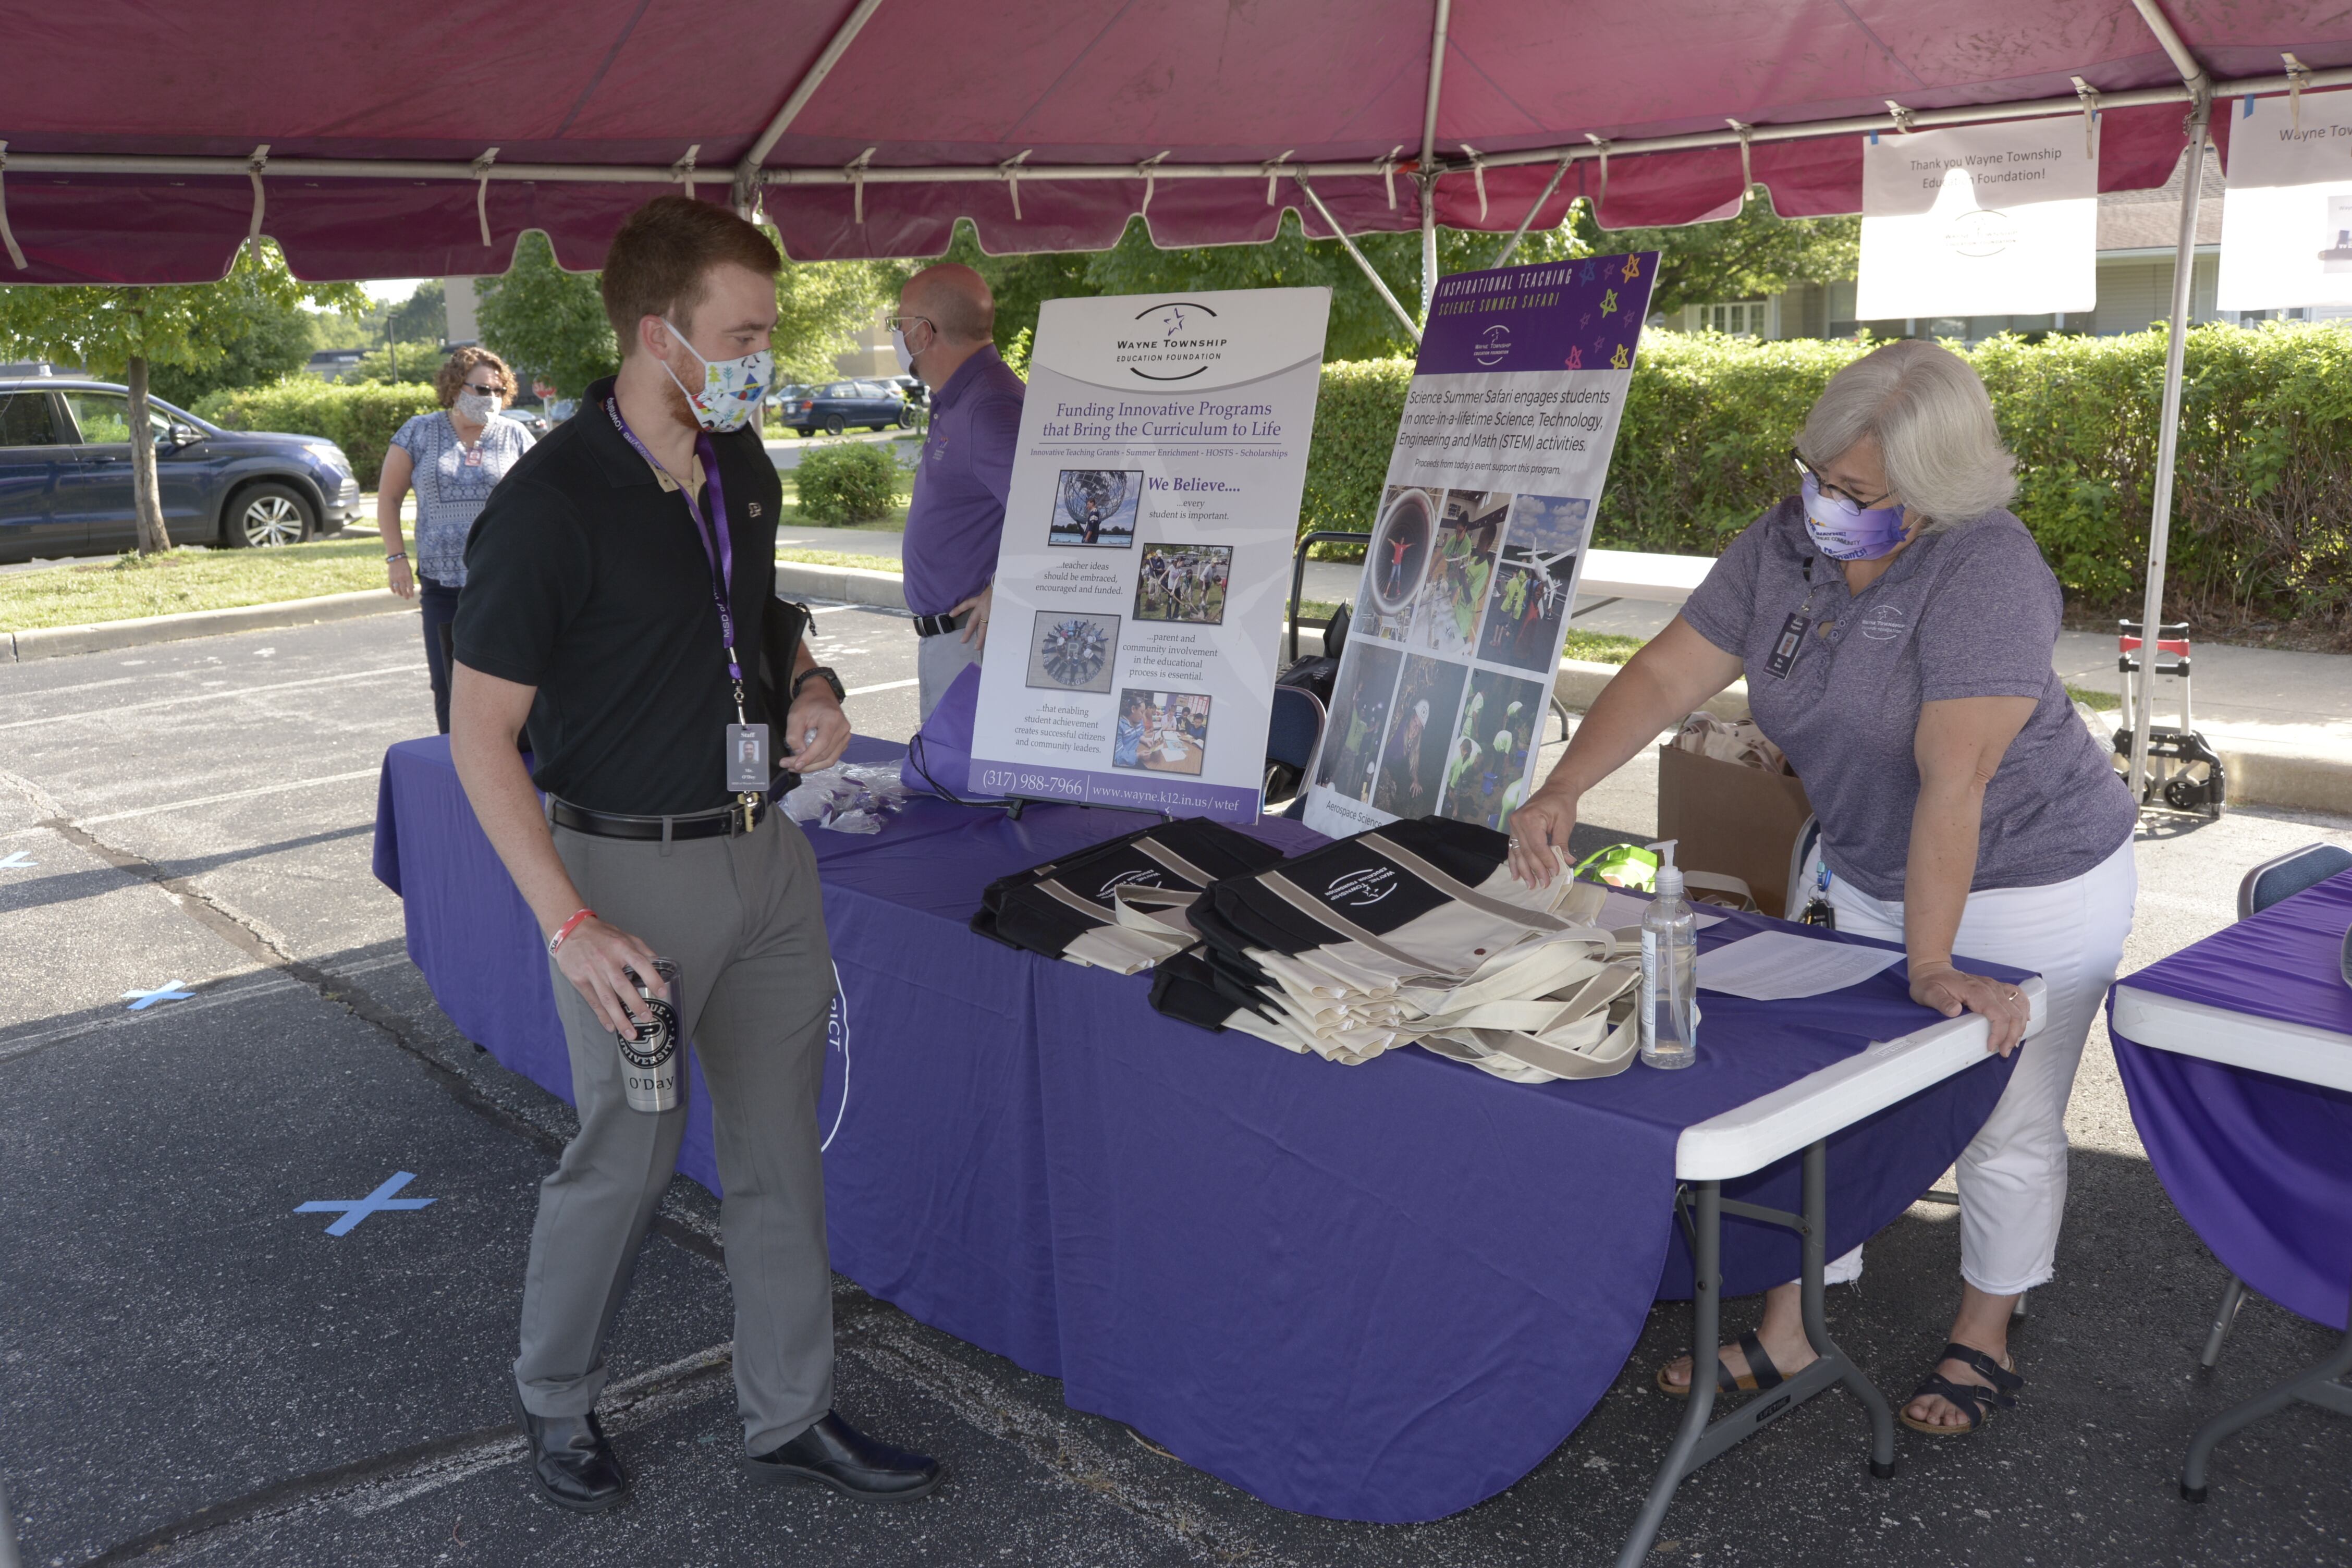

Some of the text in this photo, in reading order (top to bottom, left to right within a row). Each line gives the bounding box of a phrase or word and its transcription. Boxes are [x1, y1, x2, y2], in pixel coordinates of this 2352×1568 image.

[1910, 148, 2062, 171] Thank you Wayne Township
[1922, 168, 2045, 189] Educn Foundation!
[1439, 268, 1573, 297] INSPIRATIONAL TEACHING
[1439, 292, 1560, 316] SCIENCE SUMMER SAFARI
[1117, 339, 1228, 349] WAYNE TOWNSHIP
[1409, 389, 1610, 407] Science Summer Safari engages students
[1056, 401, 1272, 420] Funding Innovative Programs
[1404, 411, 1603, 430] in once-in-a-lifetime Science, Technology,
[1043, 421, 1281, 440] that Bring the Curriculum to Life
[1399, 433, 1586, 451] Engineering and Math (STEM) activities.
[1066, 448, 1094, 457] Teaching
[1158, 448, 1199, 457] Enrichment
[1240, 448, 1288, 458] Scholarships
[1415, 459, 1439, 469] Proceeds
[1440, 460, 1453, 469] from
[1454, 461, 1474, 471] today's
[1492, 462, 1516, 474] support
[1518, 463, 1529, 472] this
[1530, 465, 1561, 475] program.
[1148, 477, 1241, 492] We Believe....
[1177, 500, 1205, 509] ...every
[1149, 511, 1178, 519] student
[1188, 511, 1229, 522] important.
[1831, 537, 1860, 546] COMMUNITY
[1056, 561, 1109, 570] ...teacher ideas
[1044, 572, 1118, 583] should be embraced,
[1035, 583, 1123, 595] encouraged and funded.
[721, 614, 730, 638] MSD
[1147, 634, 1195, 644] ...parent and
[1122, 644, 1218, 657] community involvement
[1134, 656, 1203, 669] in the educational
[1129, 669, 1158, 679] process
[1168, 671, 1203, 681] essential.
[1036, 704, 1089, 718] ...that enabling
[1024, 715, 1098, 729] student achievement
[1014, 727, 1106, 742] creates successful citizens
[1015, 738, 1101, 753] and community leaders.
[983, 769, 1240, 811] (317) 988-7966 www.wayne.k12.in.us/wtef
[1326, 800, 1382, 828] Aerospace Science
[1324, 867, 1388, 896] EDUCATION FOUNDATION
[1330, 871, 1395, 901] WAYNE TOWNSHIP
[619, 1034, 675, 1065] UNIVERSITY
[629, 1076, 674, 1091] O'Day
